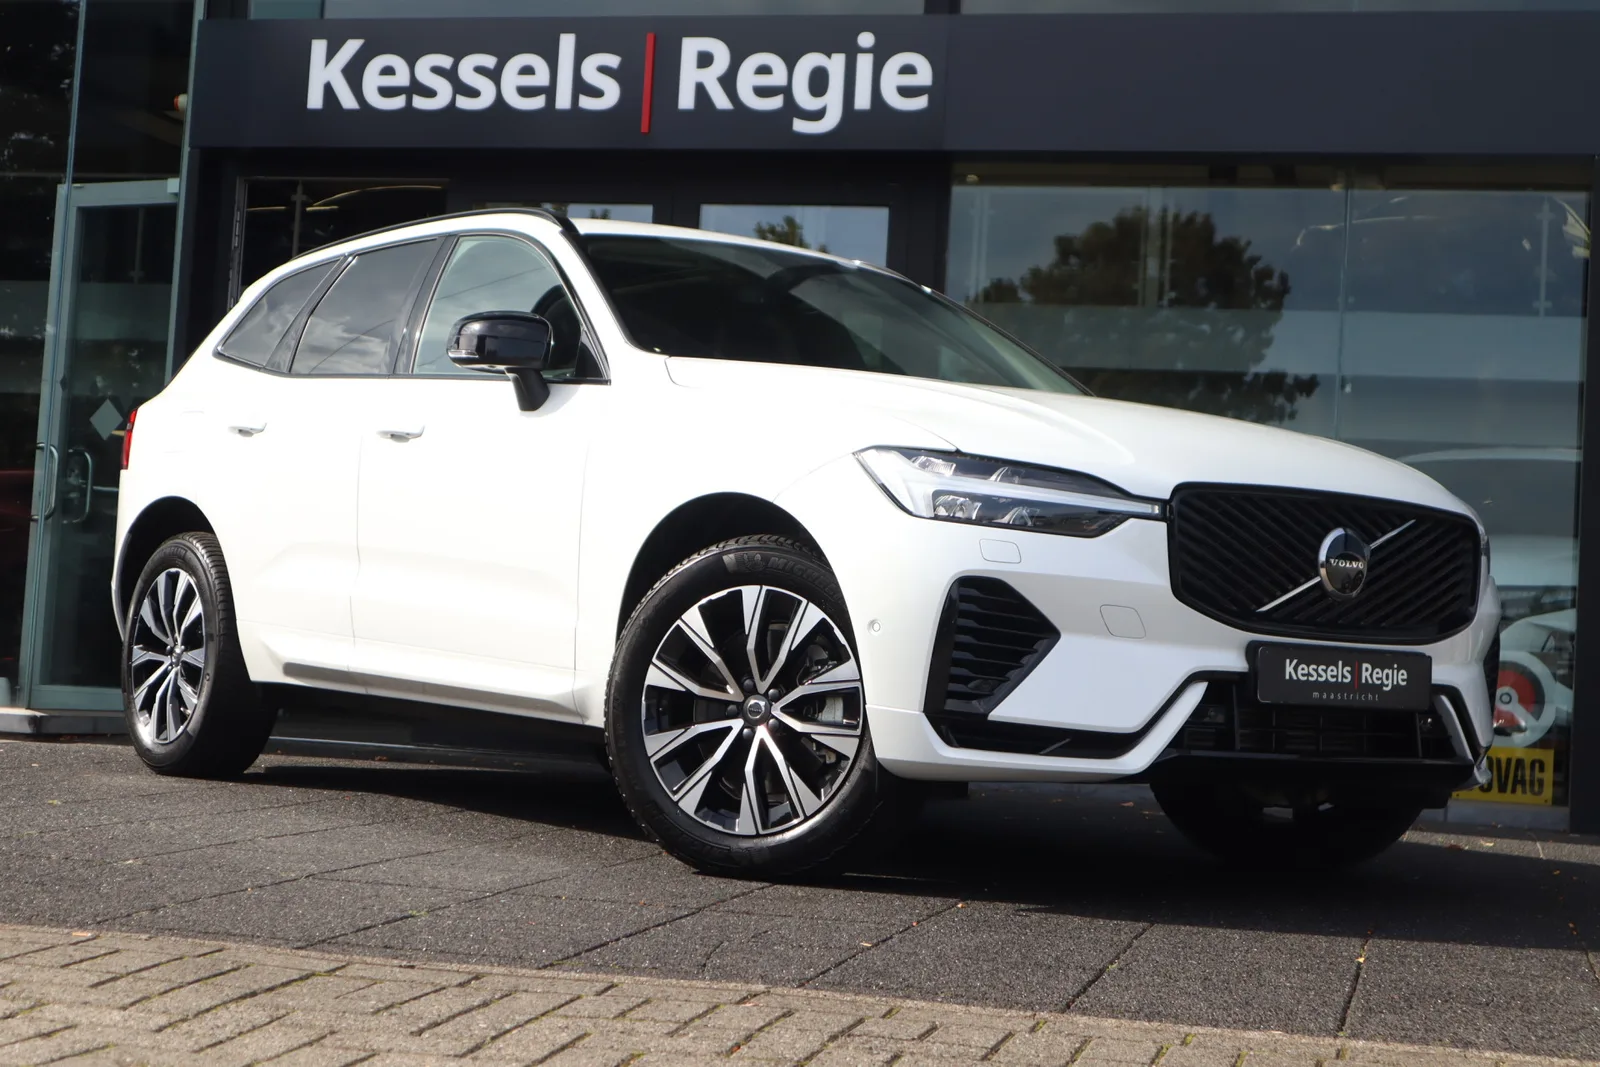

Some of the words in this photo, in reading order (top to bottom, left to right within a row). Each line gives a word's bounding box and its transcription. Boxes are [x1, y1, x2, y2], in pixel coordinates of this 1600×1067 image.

[306, 32, 622, 111] Kessels
[677, 31, 933, 134] Regie
[1329, 558, 1364, 569] VOLVO
[1285, 658, 1352, 683] Kessels
[1361, 662, 1408, 691] Regie
[1312, 691, 1379, 701] maastricht
[1478, 755, 1546, 797] OVAG
